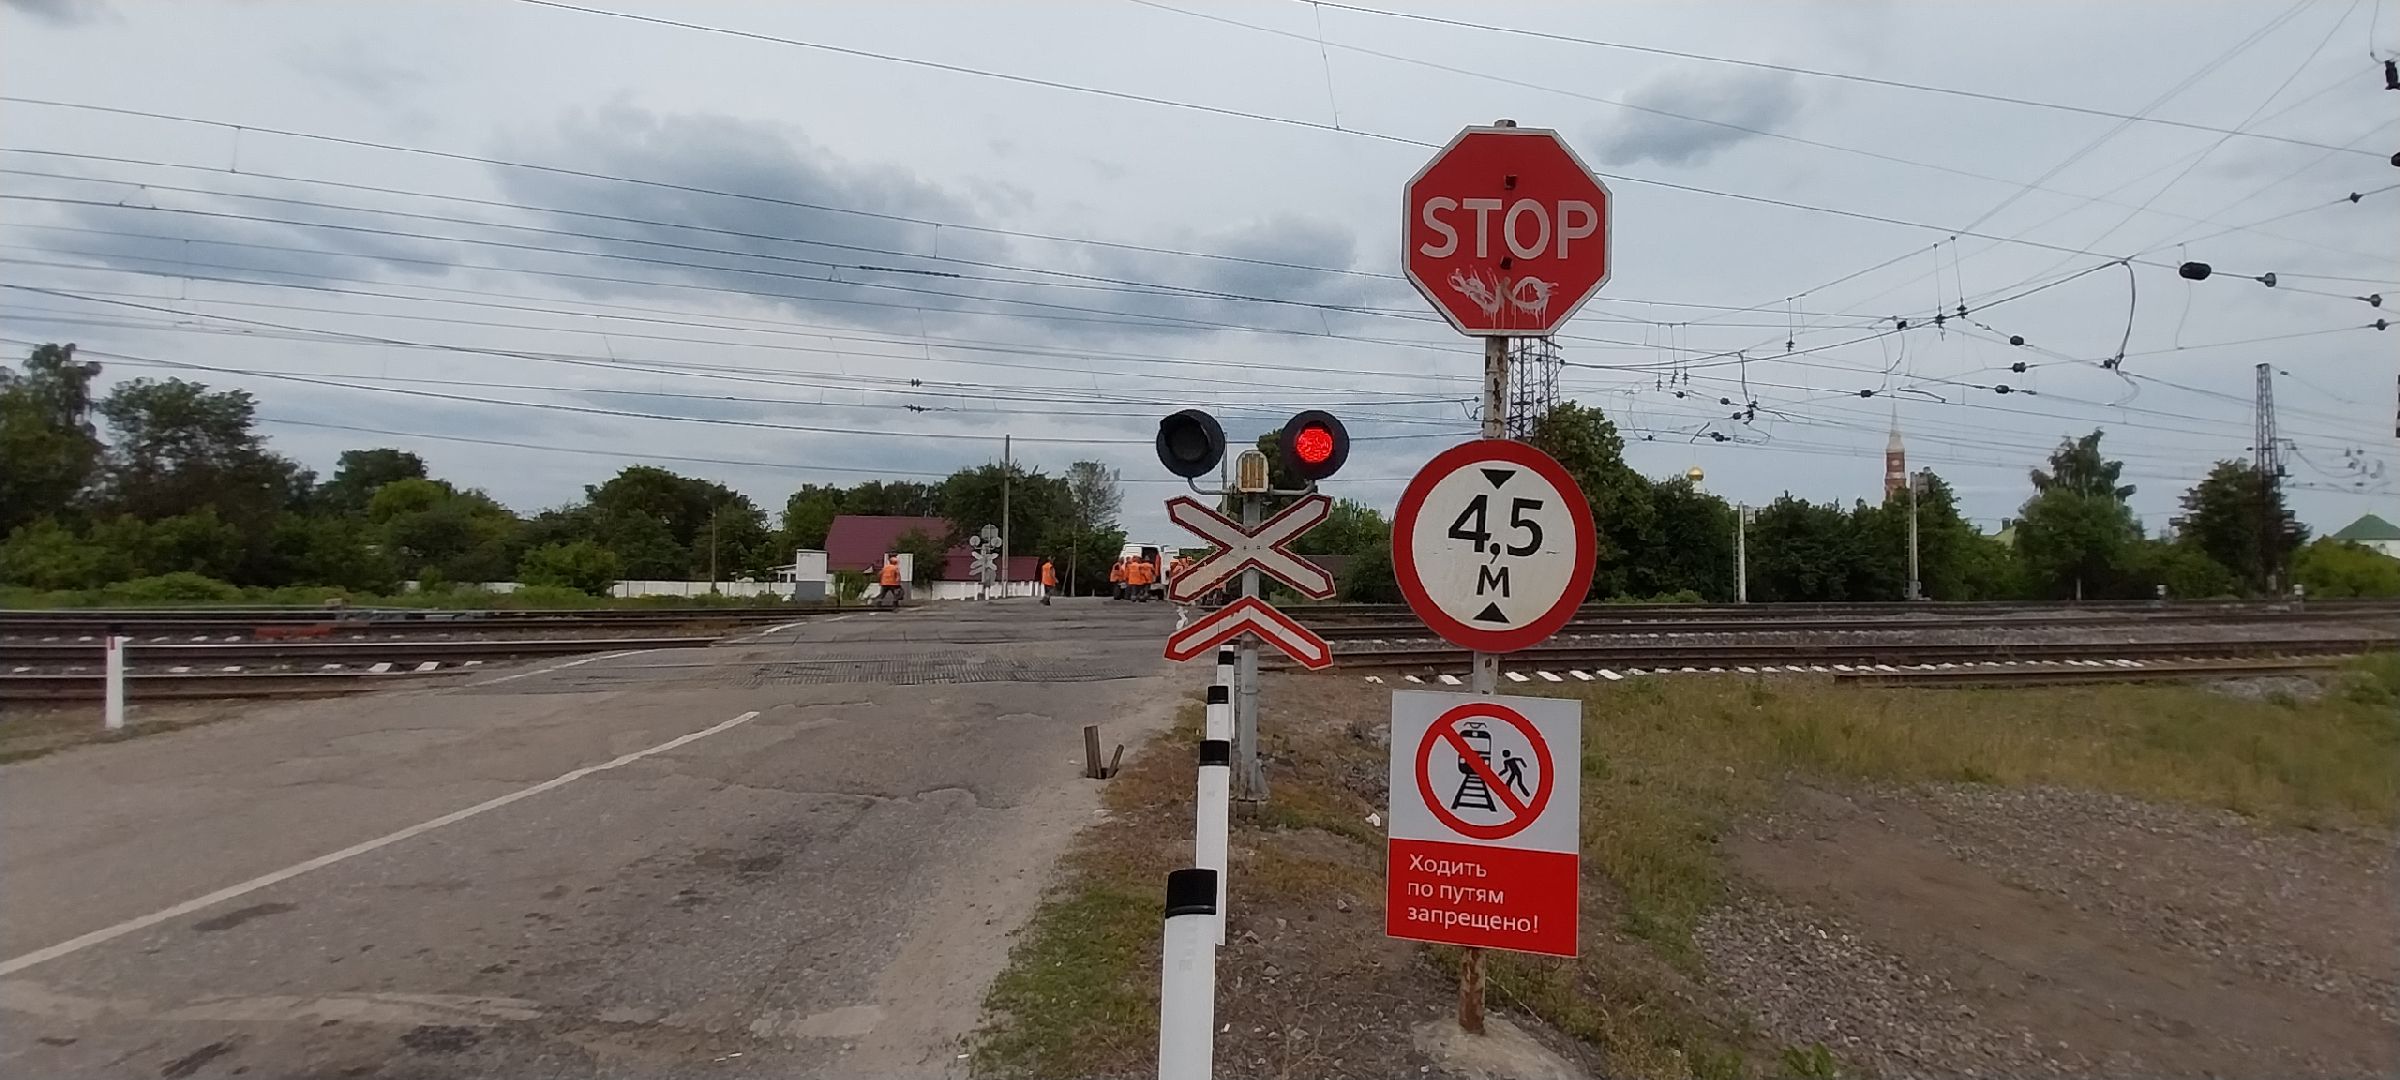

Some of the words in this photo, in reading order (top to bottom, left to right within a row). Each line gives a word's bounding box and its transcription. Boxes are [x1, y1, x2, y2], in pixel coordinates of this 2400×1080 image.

[1419, 196, 1598, 260] STOP
[1448, 494, 1544, 564] 4,5
[1409, 854, 1487, 877] Ходить
[1407, 882, 1433, 897] по
[1439, 884, 1504, 905] путям
[1407, 906, 1539, 934] запрещено!
